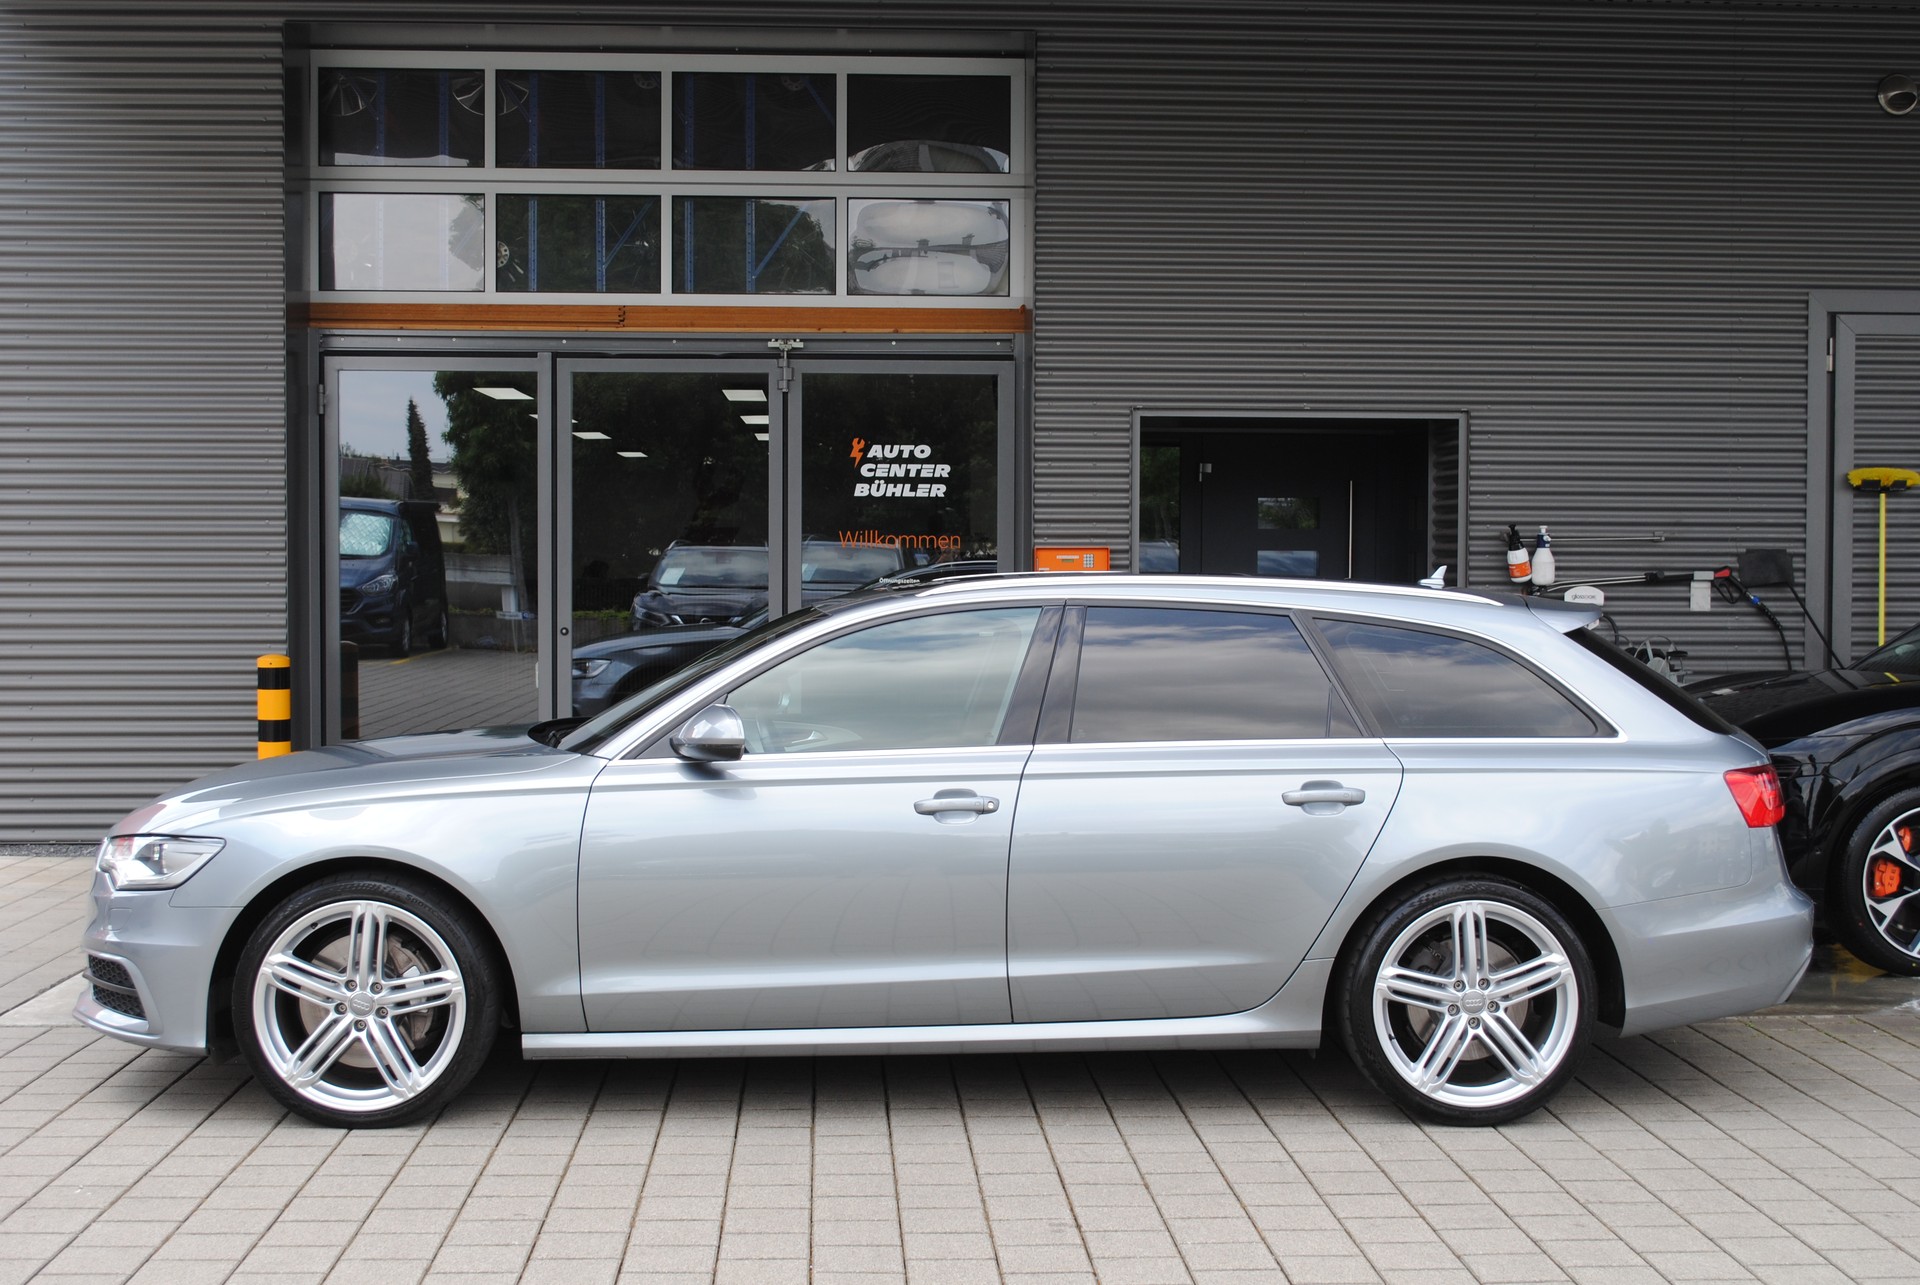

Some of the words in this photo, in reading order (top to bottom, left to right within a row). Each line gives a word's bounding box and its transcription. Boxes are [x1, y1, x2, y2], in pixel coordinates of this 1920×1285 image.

[867, 445, 931, 458] AUTO
[860, 463, 951, 477] CENTER
[854, 480, 947, 497] BÜHLER
[839, 530, 960, 549] Willkommen
